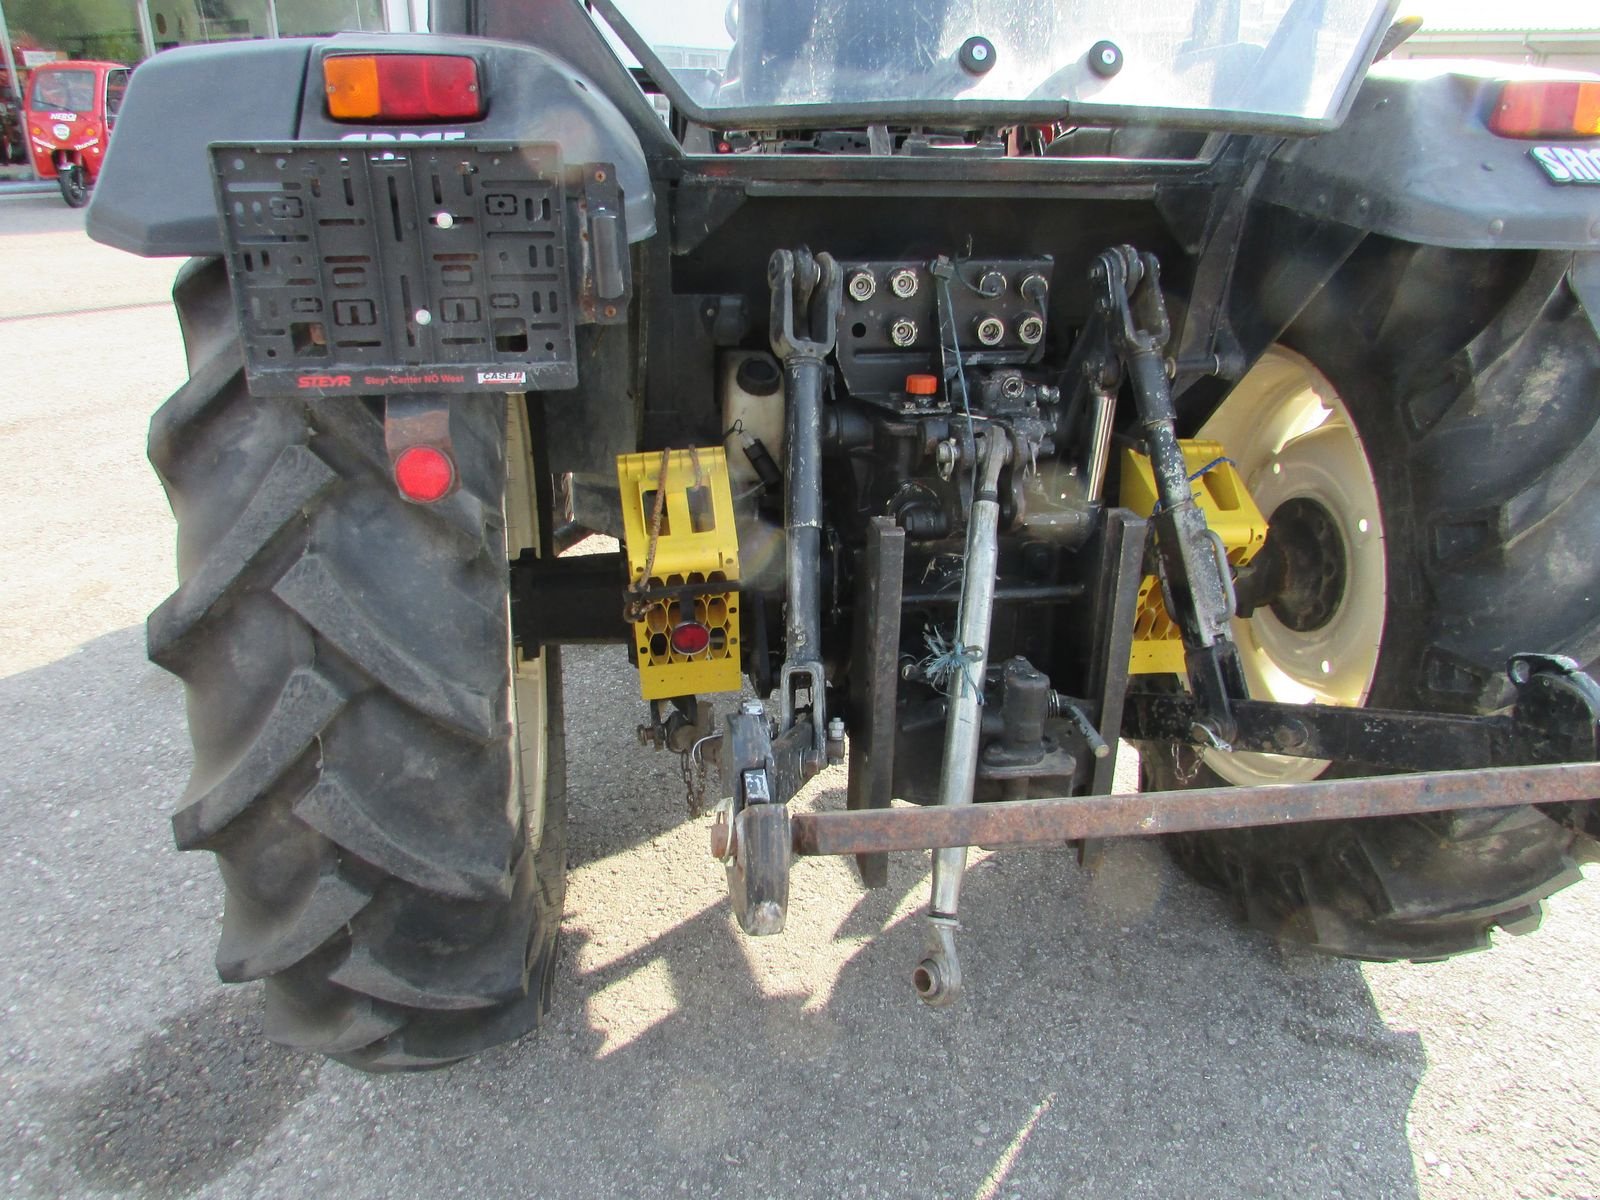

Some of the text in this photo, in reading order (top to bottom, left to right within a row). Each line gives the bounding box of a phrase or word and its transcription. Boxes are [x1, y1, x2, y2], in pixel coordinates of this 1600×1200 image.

[297, 375, 352, 388] STEYR
[364, 375, 389, 386] Steyr
[390, 375, 422, 384] Center
[440, 374, 464, 383] West
[483, 372, 513, 380] CASE
